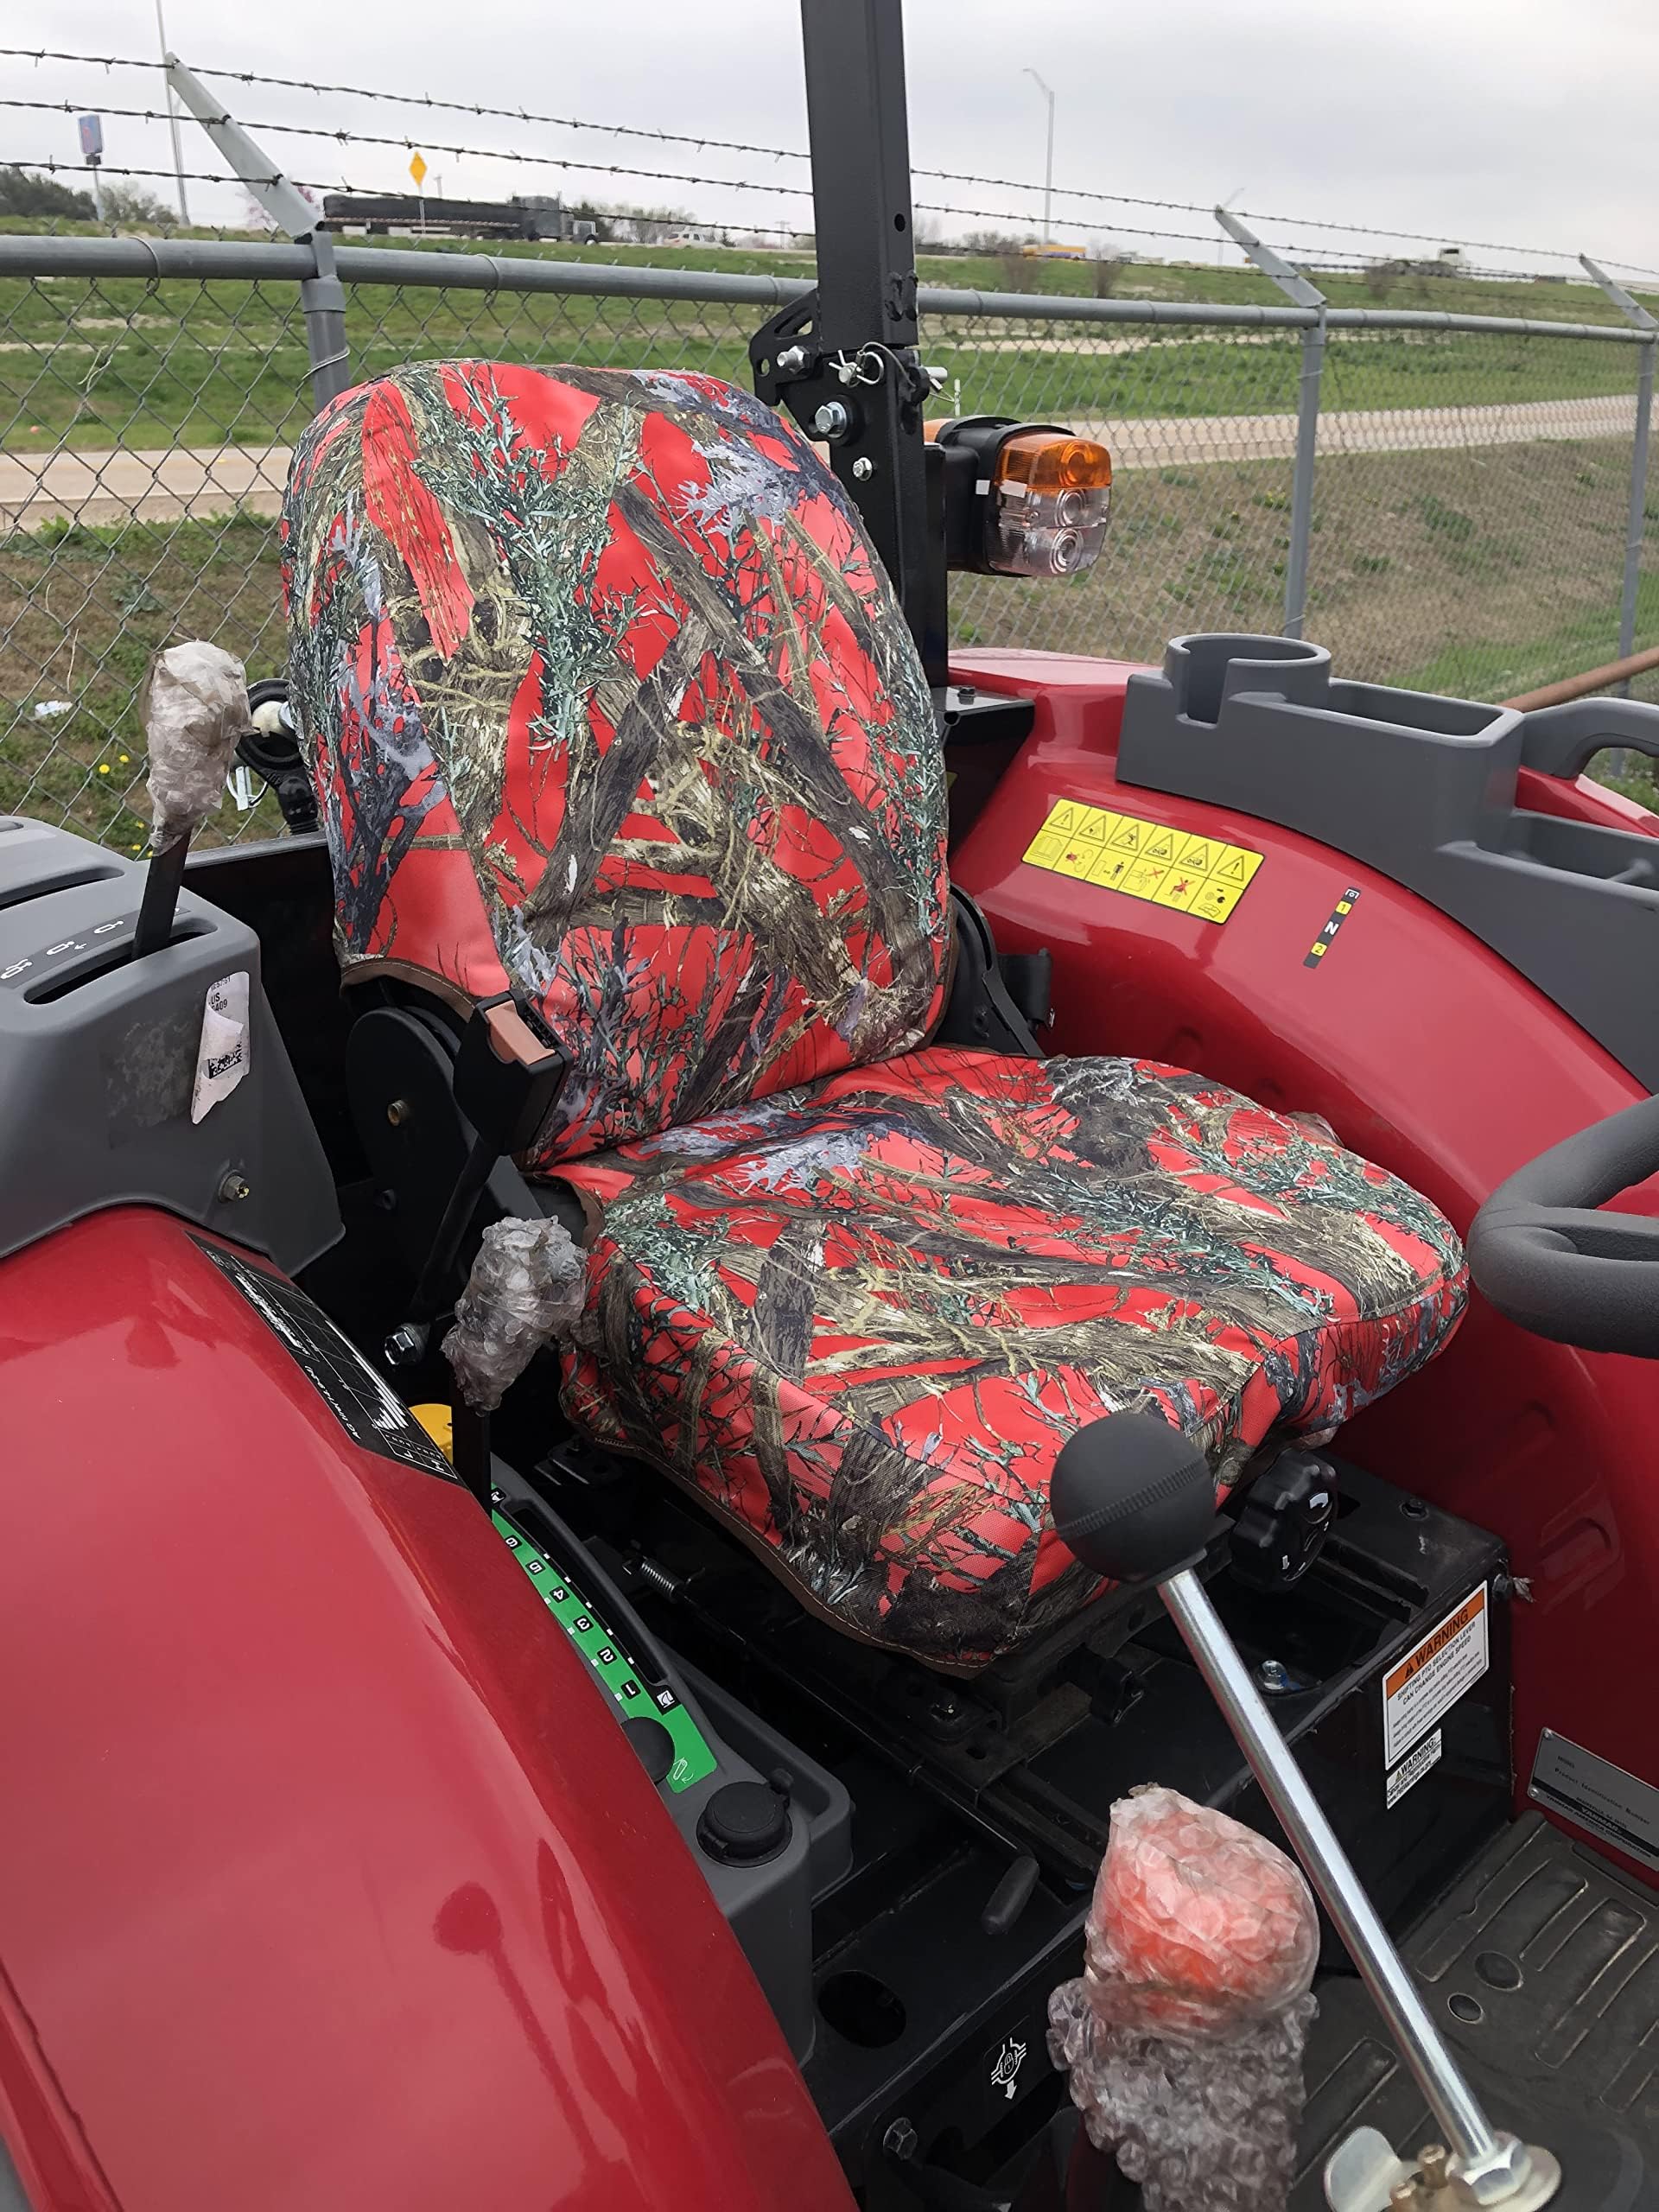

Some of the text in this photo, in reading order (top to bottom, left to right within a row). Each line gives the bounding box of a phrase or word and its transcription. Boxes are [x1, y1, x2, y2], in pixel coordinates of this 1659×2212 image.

[1324, 921, 1339, 935] N
[1315, 945, 1323, 953] 2
[505, 1537, 518, 1547] 6
[529, 1562, 543, 1573] 5
[553, 1589, 564, 1600] 4
[577, 1618, 590, 1630] 3
[1415, 1608, 1468, 1667] WARNING
[600, 1649, 613, 1662] 2
[1398, 1621, 1475, 1700] SHIFTING PTO SELECTION LEVER
[1403, 1635, 1471, 1705] CAN CHANGE ENGINE SPEED
[625, 1684, 636, 1695] 1
[1401, 1737, 1436, 1774] WARNING:
